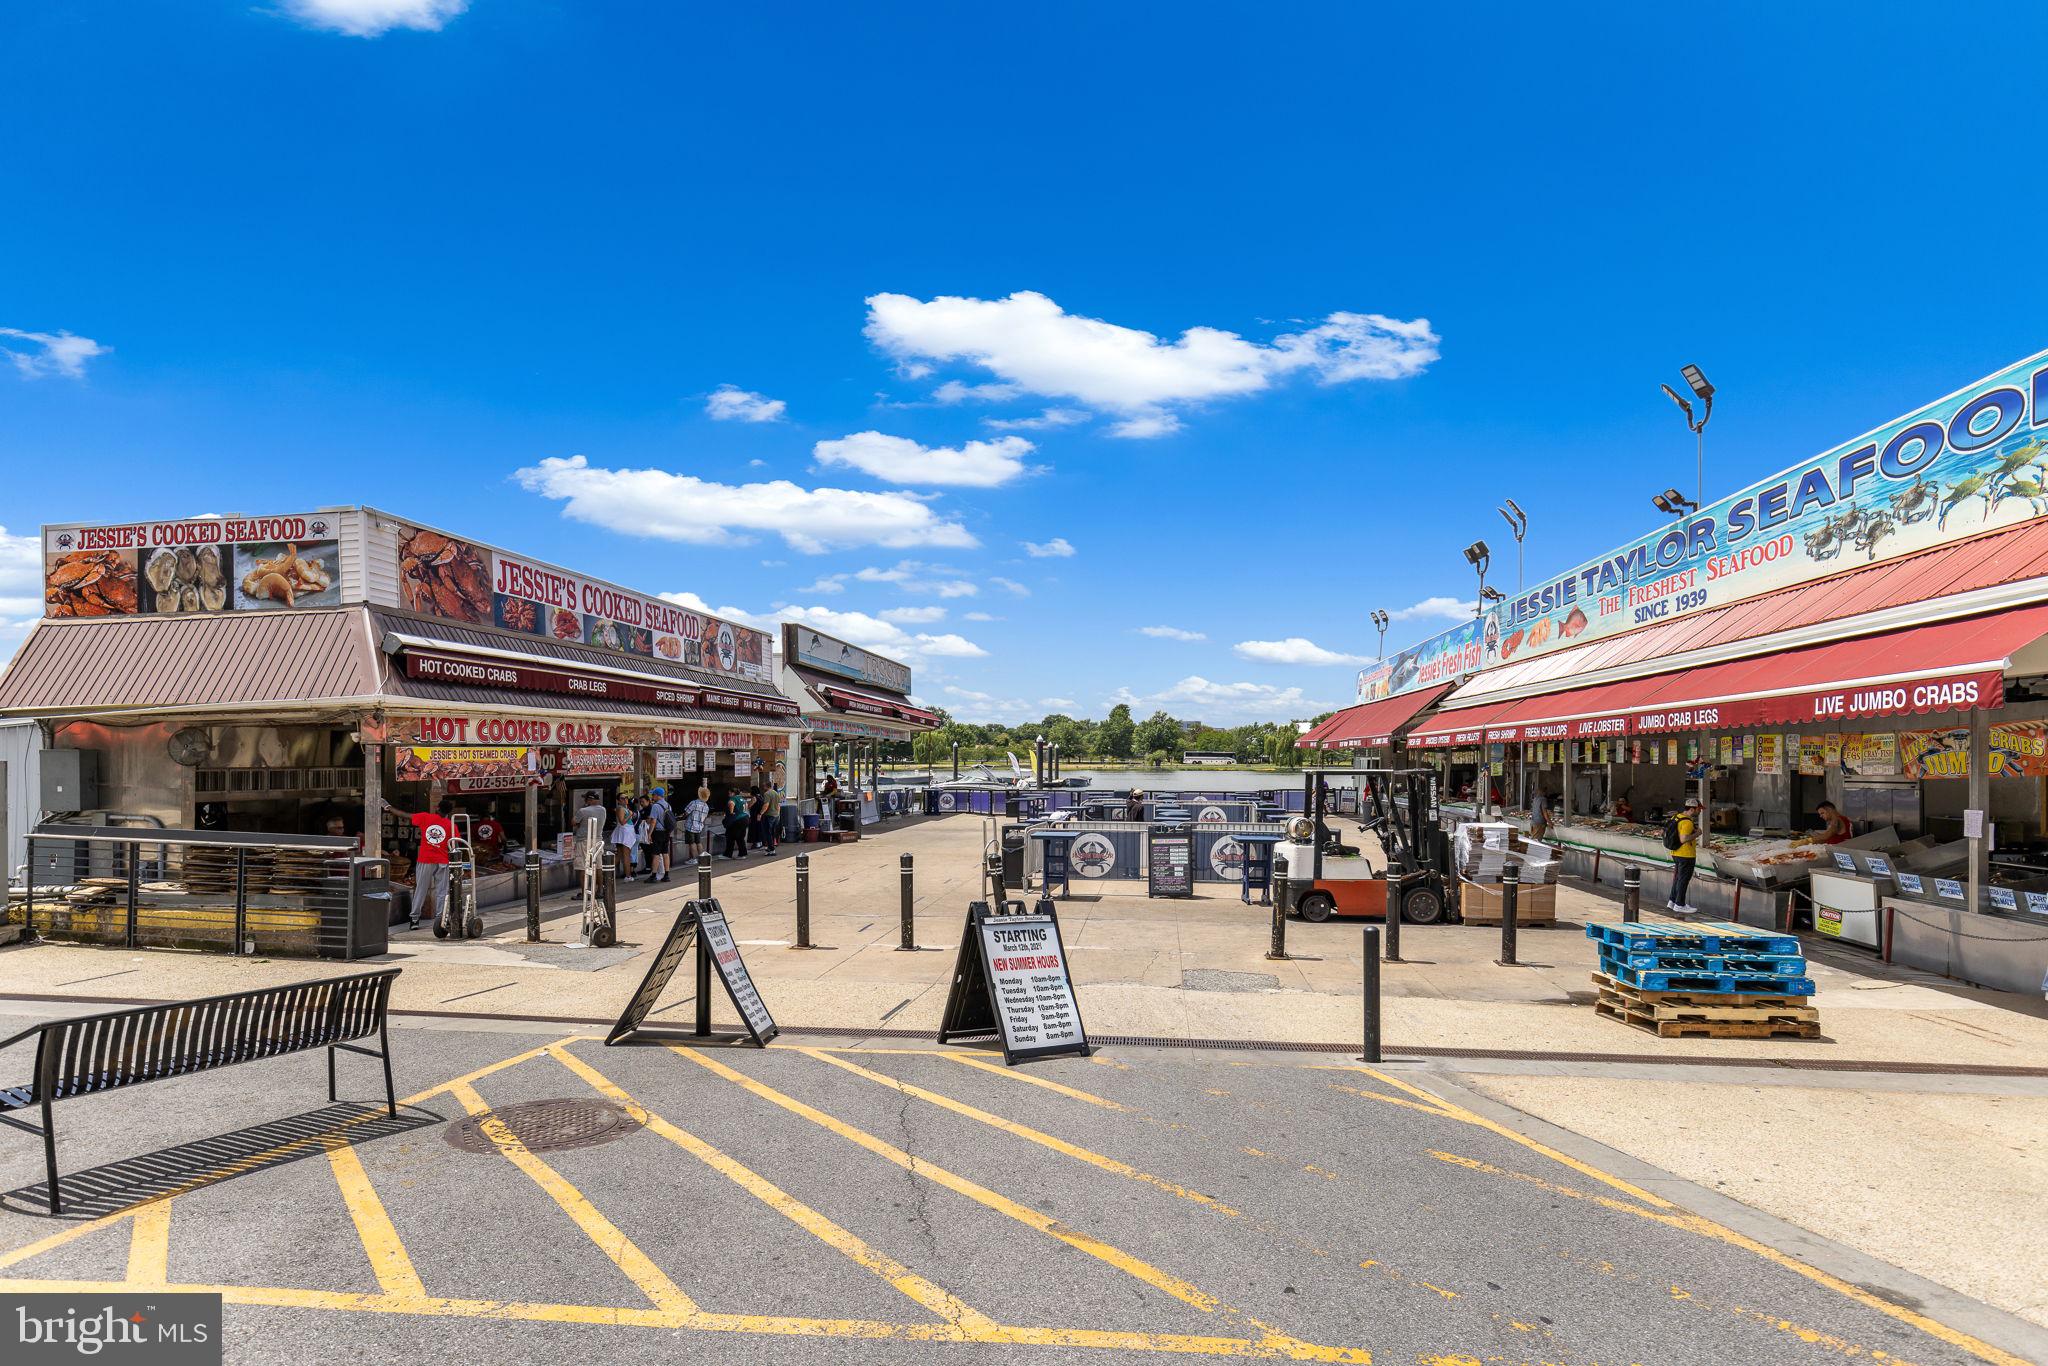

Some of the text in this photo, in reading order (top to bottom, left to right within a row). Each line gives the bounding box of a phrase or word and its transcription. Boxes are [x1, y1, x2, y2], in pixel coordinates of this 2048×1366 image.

[1506, 365, 2048, 628] JESSIE TAYLOR SEAFOO
[77, 518, 306, 550] JESSIE'S COOKED SEAFOOD
[1598, 534, 1794, 617] THE FRESHEST SEAFOOD
[497, 559, 701, 640] JESSIE'S COOKED SEAFOOD
[1634, 588, 1708, 624] SINCE 1939
[1417, 658, 1441, 684] Jessie's
[1442, 645, 1462, 676] Fresh
[1464, 636, 1482, 670] Fish
[419, 659, 518, 683] HOT COOKED CRABS
[568, 678, 607, 693] CRAB LEGS
[656, 691, 695, 704] SPICED SHRIMP
[706, 694, 740, 707] MAINE LOBSTER
[1814, 681, 1979, 716] LIVE JUMBO CRABS
[1638, 708, 1719, 729] JUMBO CRAB LEGS
[419, 717, 603, 744] HOT COOKED CRABS
[1488, 728, 1516, 739] FRESH SHRIMP
[1525, 724, 1568, 738] FRESH SCALLOPS
[1579, 719, 1625, 734] LIVE LOBSTER
[662, 728, 752, 748] HOT SPICED SHRIMP
[1990, 730, 2045, 758] CRABS
[429, 749, 518, 760] JESSIE'S HOT STEAMED CRABS
[1900, 737, 1928, 763] LIVE
[1924, 751, 2006, 776] JUMO
[468, 777, 527, 789] 202-554-4
[1429, 776, 1437, 808] NISSAN
[993, 928, 1047, 943] STARTING
[1003, 944, 1016, 952] March
[993, 955, 1059, 972] NEW SUMMER HOURS
[1000, 975, 1061, 986] Monday 10am-8pm
[1001, 984, 1064, 995] Tuesday 10am-8pm
[1004, 993, 1066, 1004] Wednesday 10am-8pm
[1007, 1003, 1069, 1014] Thursday 10am-8pm
[1009, 1012, 1070, 1024] Friday 9am-8pm
[1012, 1021, 1072, 1033] Saturday 8am-8pm
[1014, 1030, 1074, 1043] Sunday 8am-8pm
